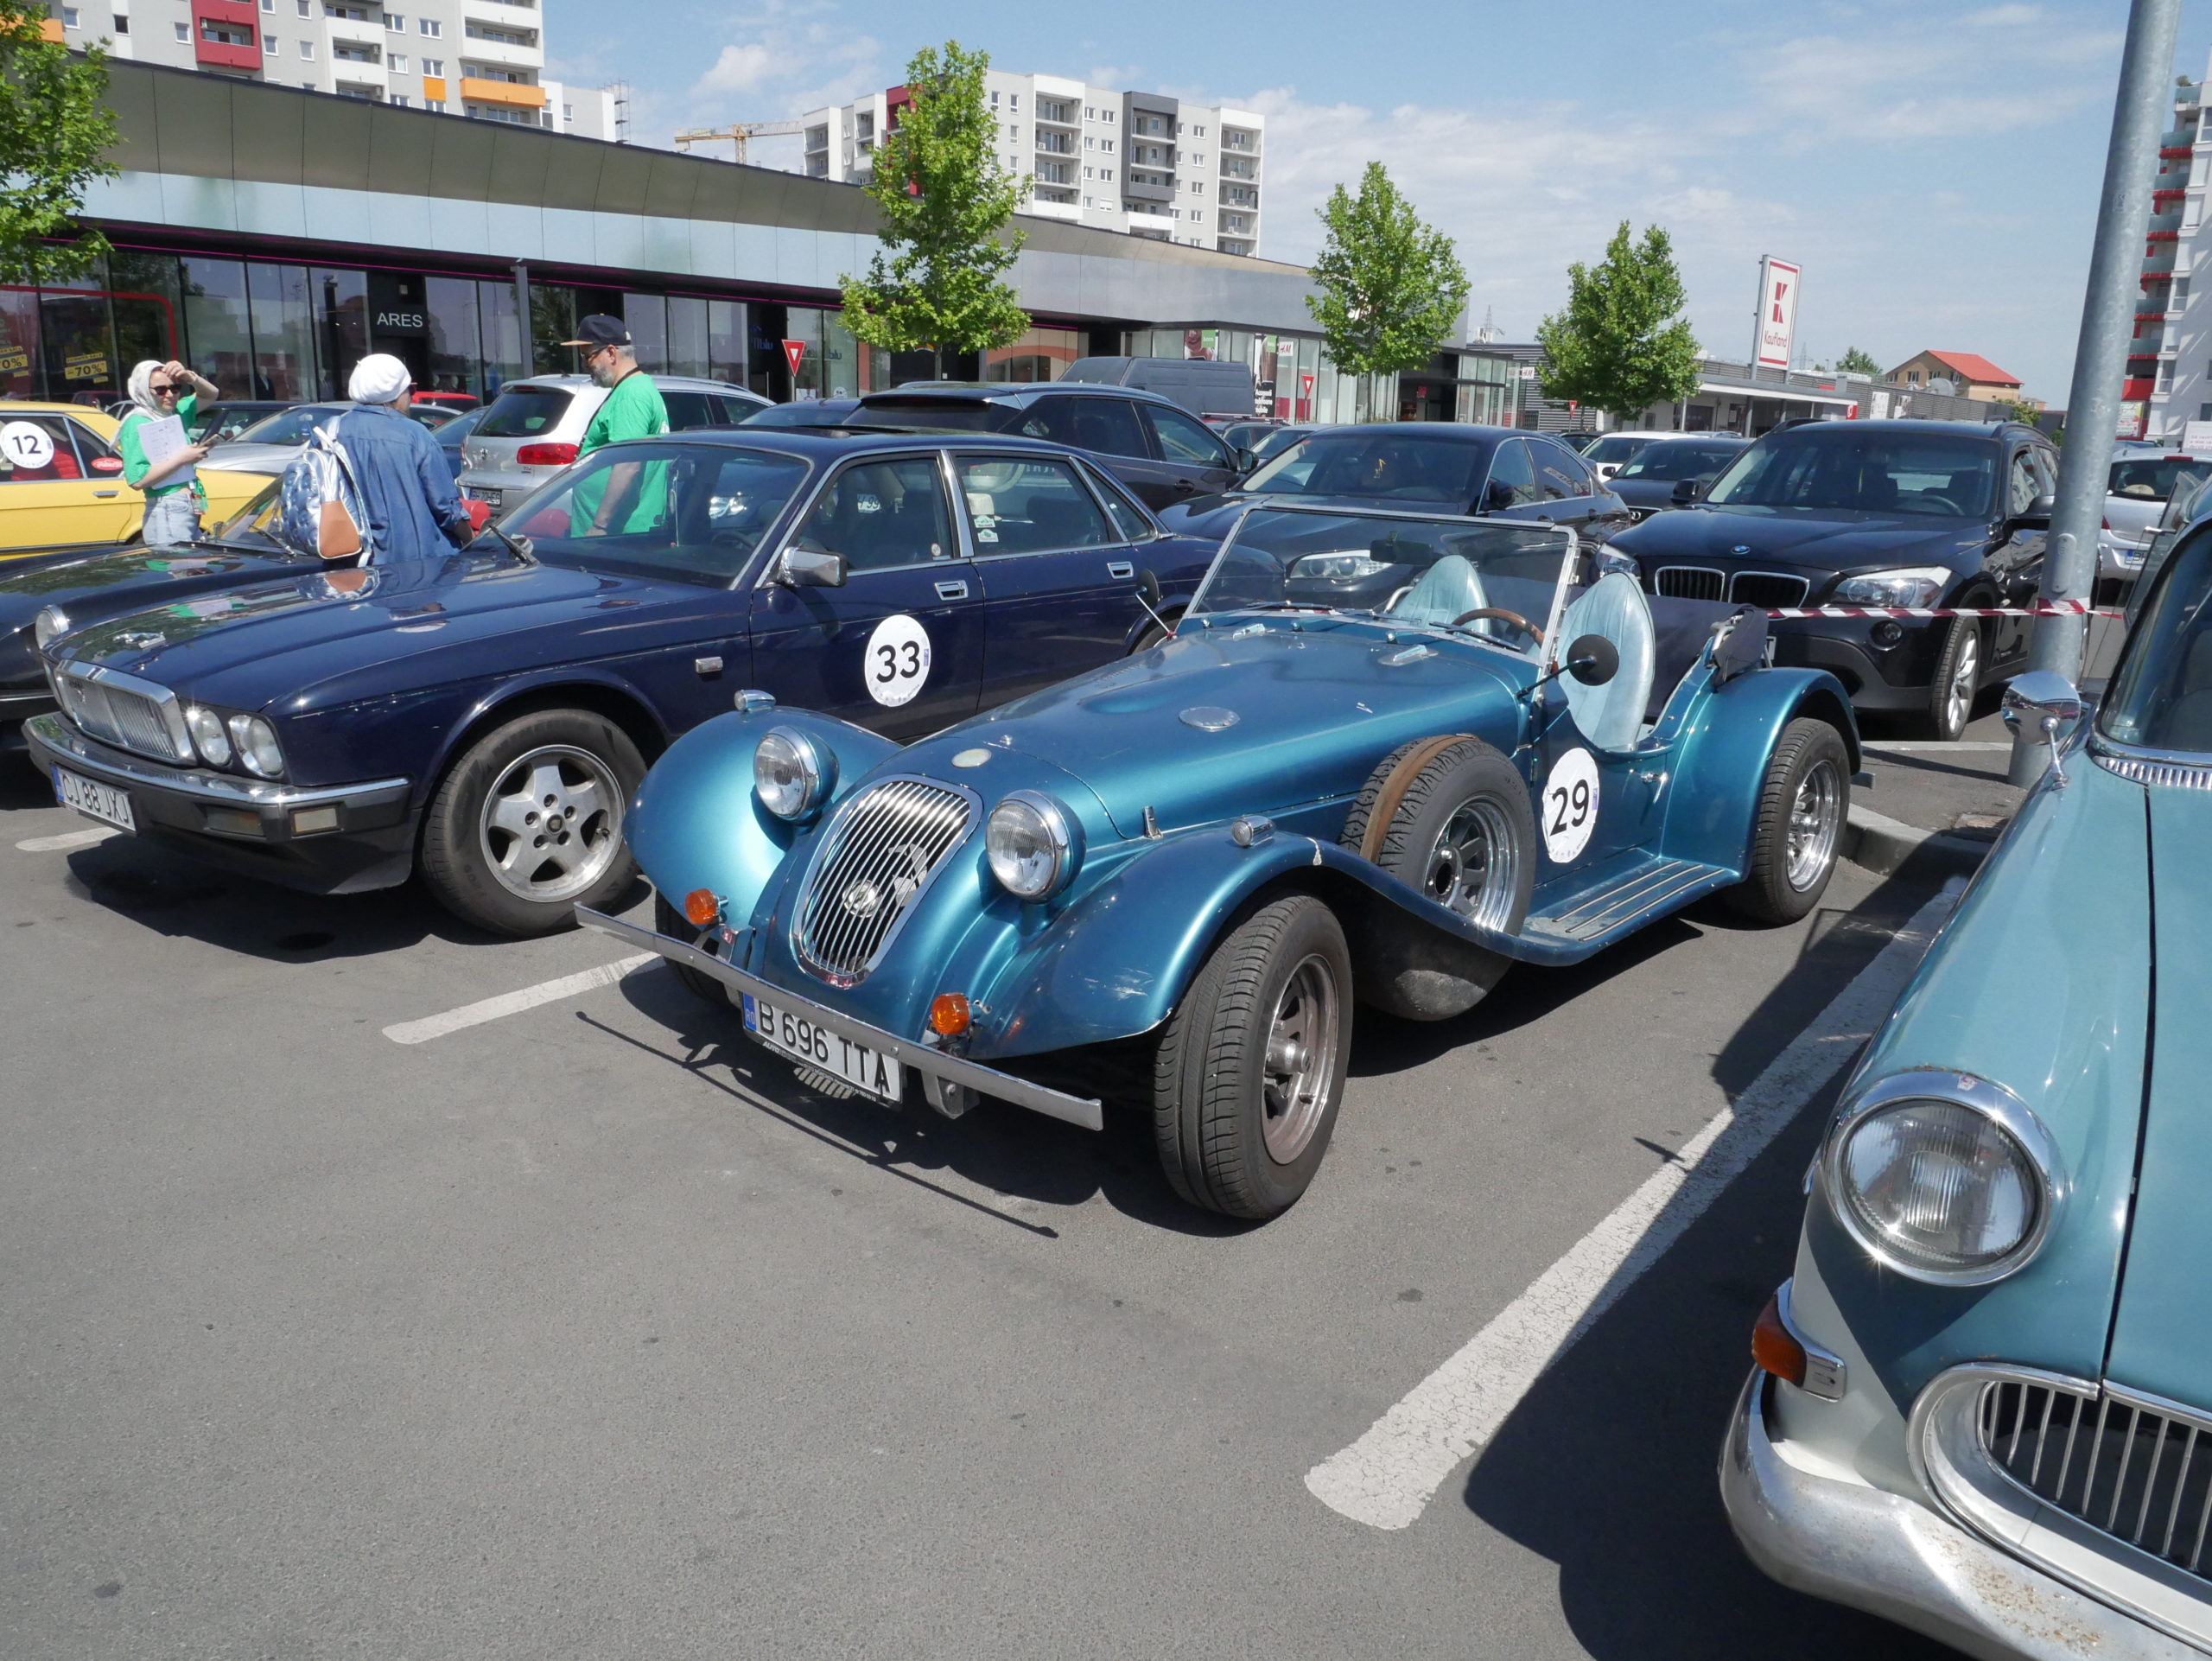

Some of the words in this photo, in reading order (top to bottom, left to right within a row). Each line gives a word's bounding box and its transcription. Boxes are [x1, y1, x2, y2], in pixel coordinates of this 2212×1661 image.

[377, 313, 423, 328] ARES
[1772, 282, 1788, 323] K
[1764, 330, 1788, 347] Kaufland
[12, 435, 41, 454] 12
[876, 640, 919, 683] 33
[62, 774, 80, 805] CJ
[82, 781, 100, 812] 88
[105, 789, 129, 824] JXJ
[1550, 780, 1589, 837] 29
[759, 1000, 775, 1036] B
[782, 1012, 829, 1063] 696
[837, 1035, 891, 1093] TTA
